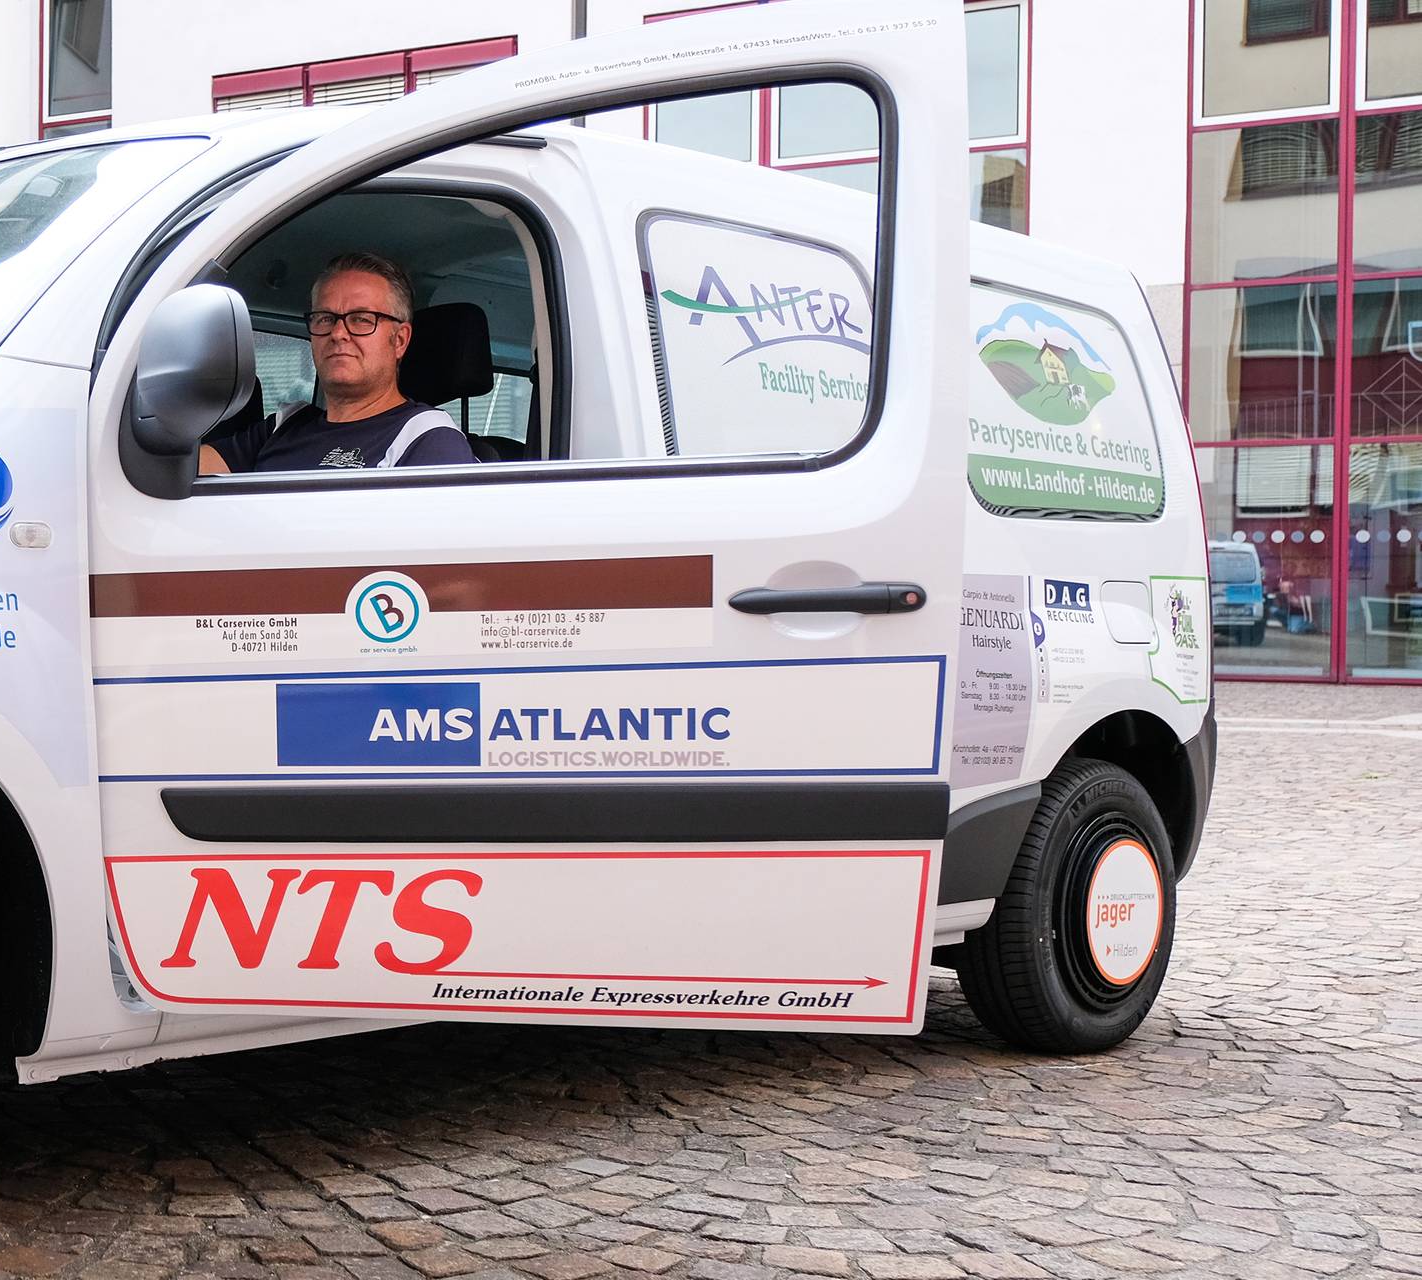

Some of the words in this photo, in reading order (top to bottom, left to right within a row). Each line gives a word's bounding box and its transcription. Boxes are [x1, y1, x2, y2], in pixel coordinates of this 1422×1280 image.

[515, 76, 556, 88] PROMOBIL
[559, 71, 582, 80] Auto-
[594, 58, 642, 73] Buswerbung
[673, 47, 725, 59] Moltkestraße
[744, 40, 771, 49] 67433
[689, 266, 863, 347] ANTER
[758, 362, 815, 403] Facility
[968, 417, 1072, 453] Partyservice
[1077, 432, 1088, 455] &
[1091, 435, 1153, 471] Catering
[1046, 584, 1087, 608] DAG
[196, 618, 214, 628] B&L
[217, 617, 266, 629] Carservice
[269, 617, 298, 628] GmbH
[481, 614, 499, 624] Tel.:
[528, 613, 551, 626] (0)21
[555, 613, 566, 624] 03
[575, 613, 586, 623] 45
[589, 612, 606, 623] 887
[1047, 610, 1095, 624] RECYCLING
[222, 630, 237, 641] Auf
[239, 630, 257, 640] dem
[260, 630, 281, 640] Sand
[283, 630, 298, 640] 30c
[481, 625, 581, 638] info@bl-carservice.de
[231, 642, 267, 652] D-40721
[270, 642, 298, 652] Hilden
[372, 646, 396, 654] service
[398, 646, 418, 655] gmbh
[481, 638, 573, 649] www.bl-carservice.de
[972, 634, 1012, 652] Hairstyle
[368, 708, 474, 742] AMS
[489, 707, 731, 741] ATLANTIC
[487, 750, 731, 768] LOGISTICS.WORLDWIDE.
[160, 867, 484, 974] NTS
[1113, 944, 1138, 957] Hilden
[431, 983, 584, 1003] Internationale
[590, 986, 770, 1008] Expressverkehre
[777, 990, 854, 1009] GmbH
